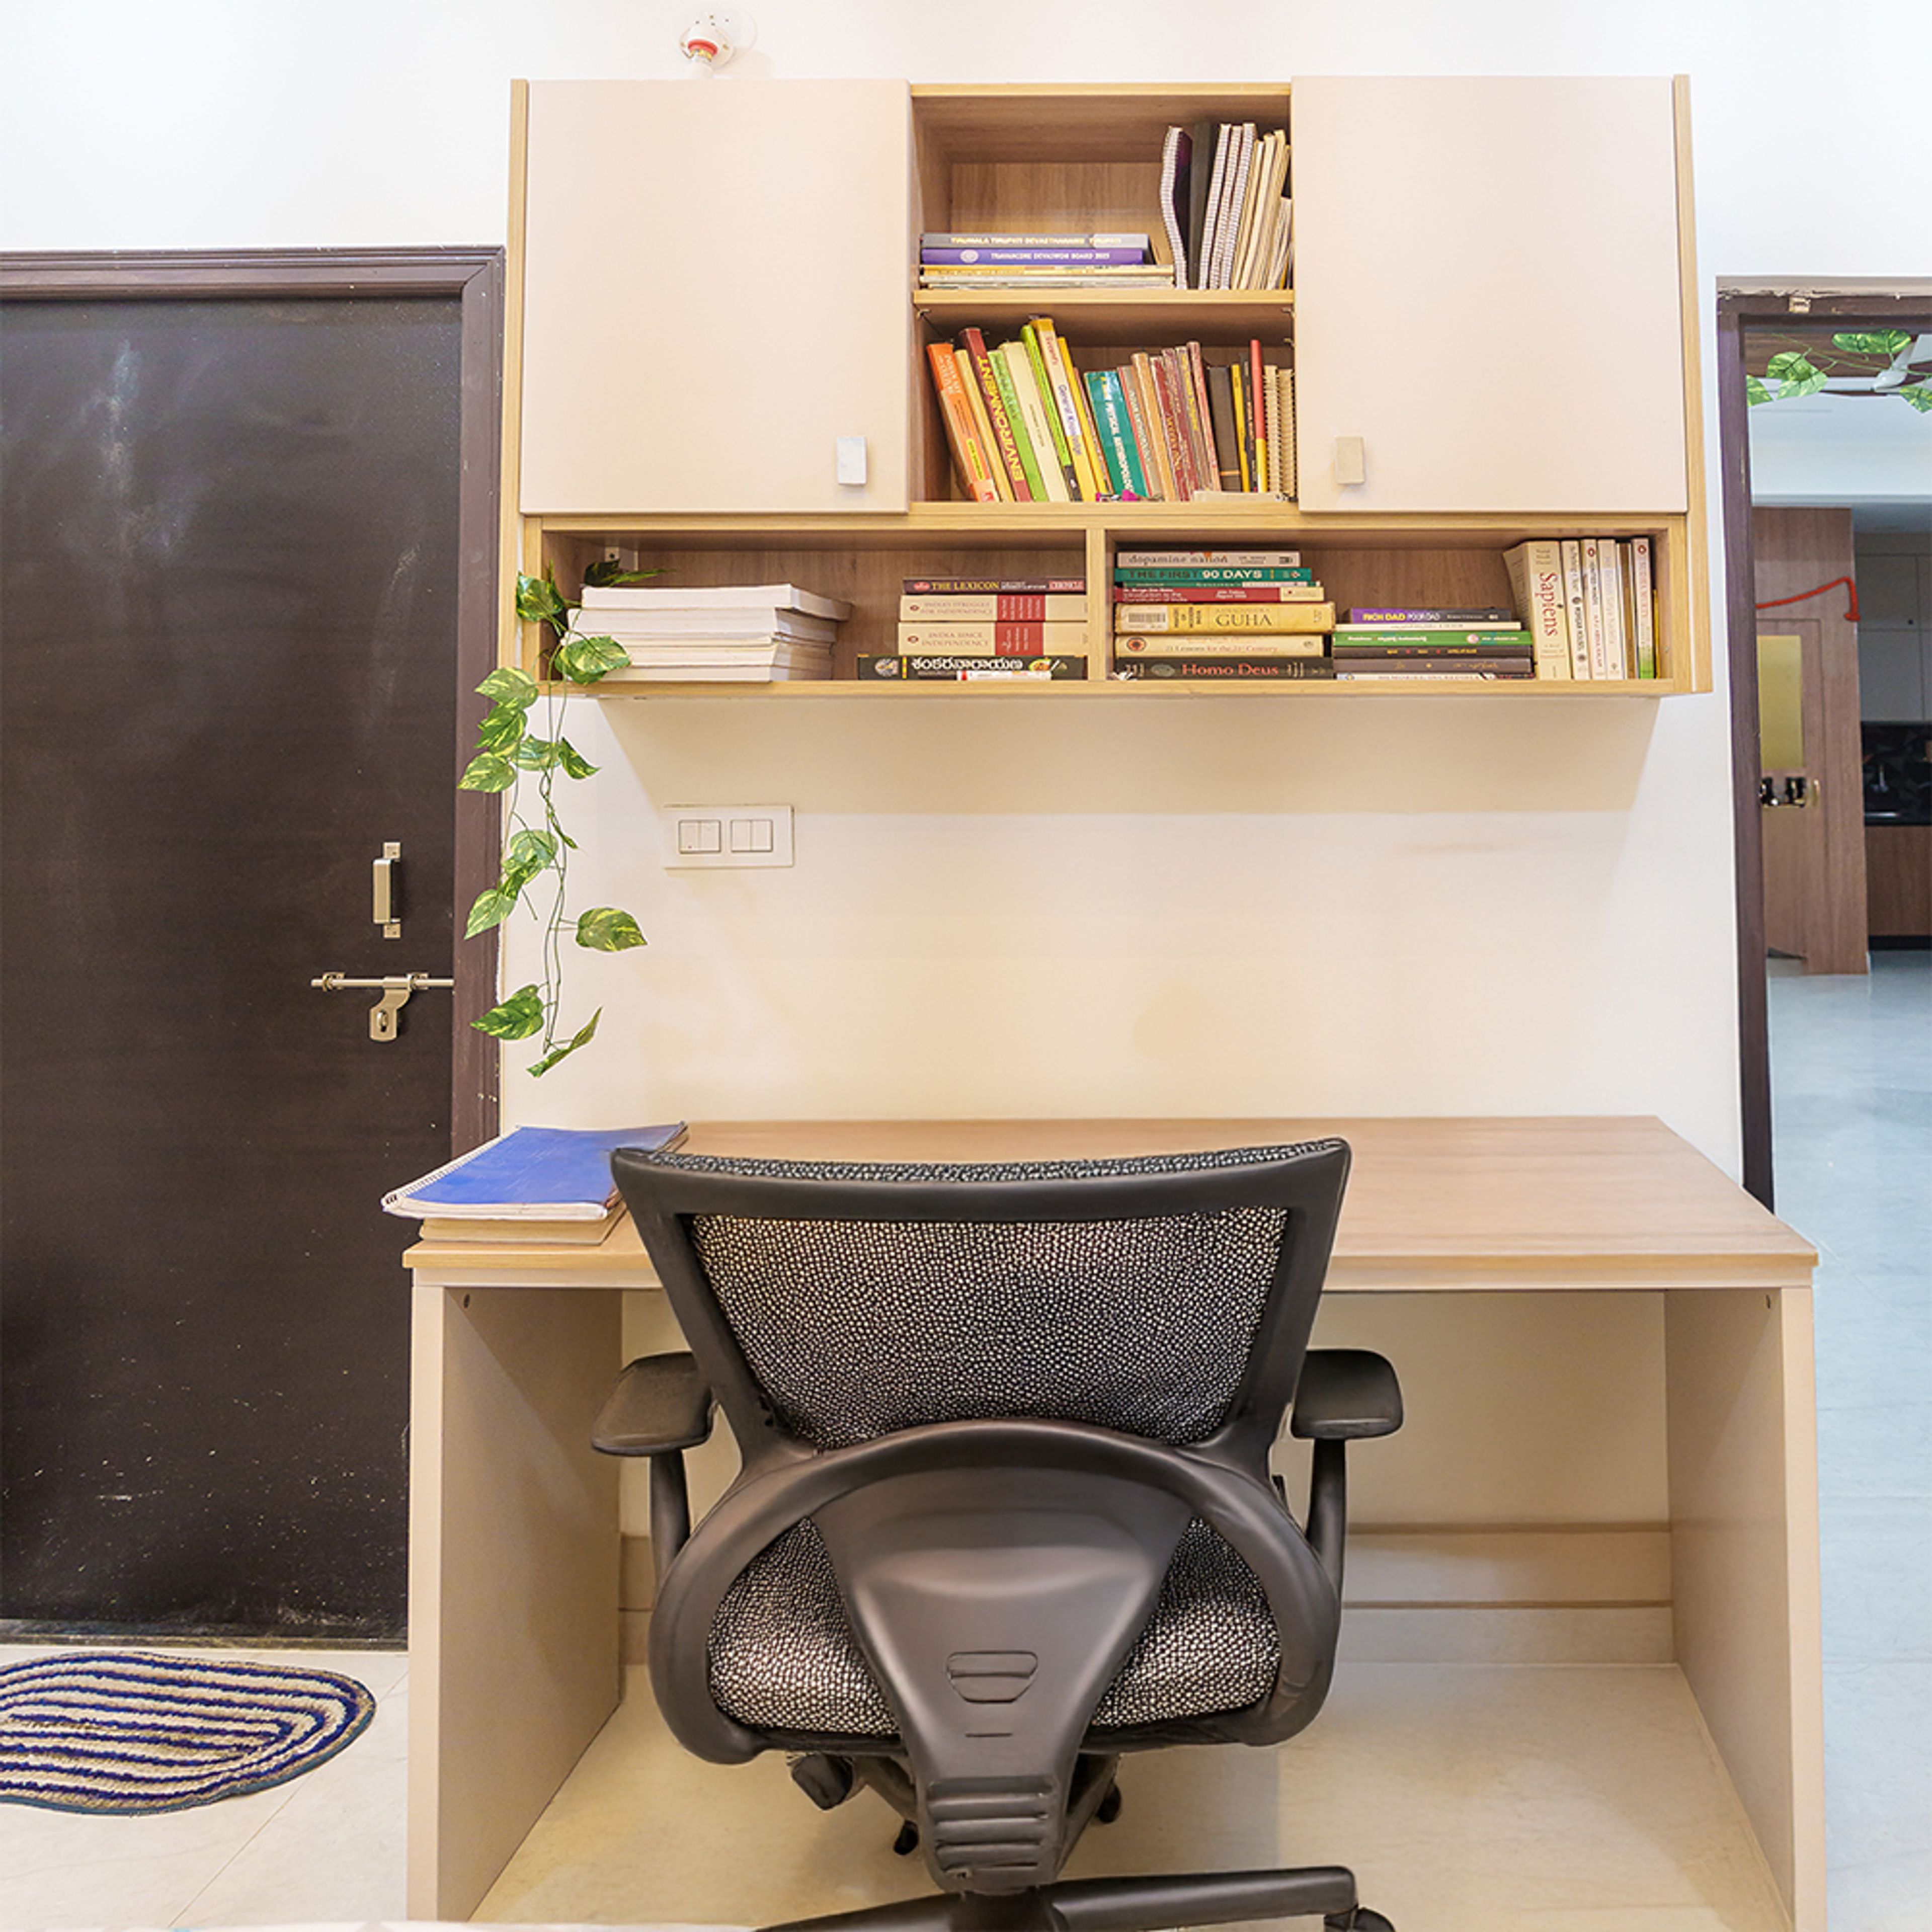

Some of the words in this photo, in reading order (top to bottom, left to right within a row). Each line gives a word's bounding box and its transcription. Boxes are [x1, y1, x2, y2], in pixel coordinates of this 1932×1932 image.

[1058, 384, 1073, 415] General
[978, 355, 1024, 481] ENVIRONMENT
[1129, 555, 1186, 565] dopamine
[1201, 570, 1220, 579] 90
[1223, 570, 1262, 579] DAYS
[931, 581, 951, 590] THE
[954, 581, 1000, 590] LEXICON
[1535, 572, 1560, 636] Sapiens
[1215, 614, 1272, 626] GUHA
[1182, 664, 1233, 675] Homo
[1238, 663, 1278, 675] Deus
